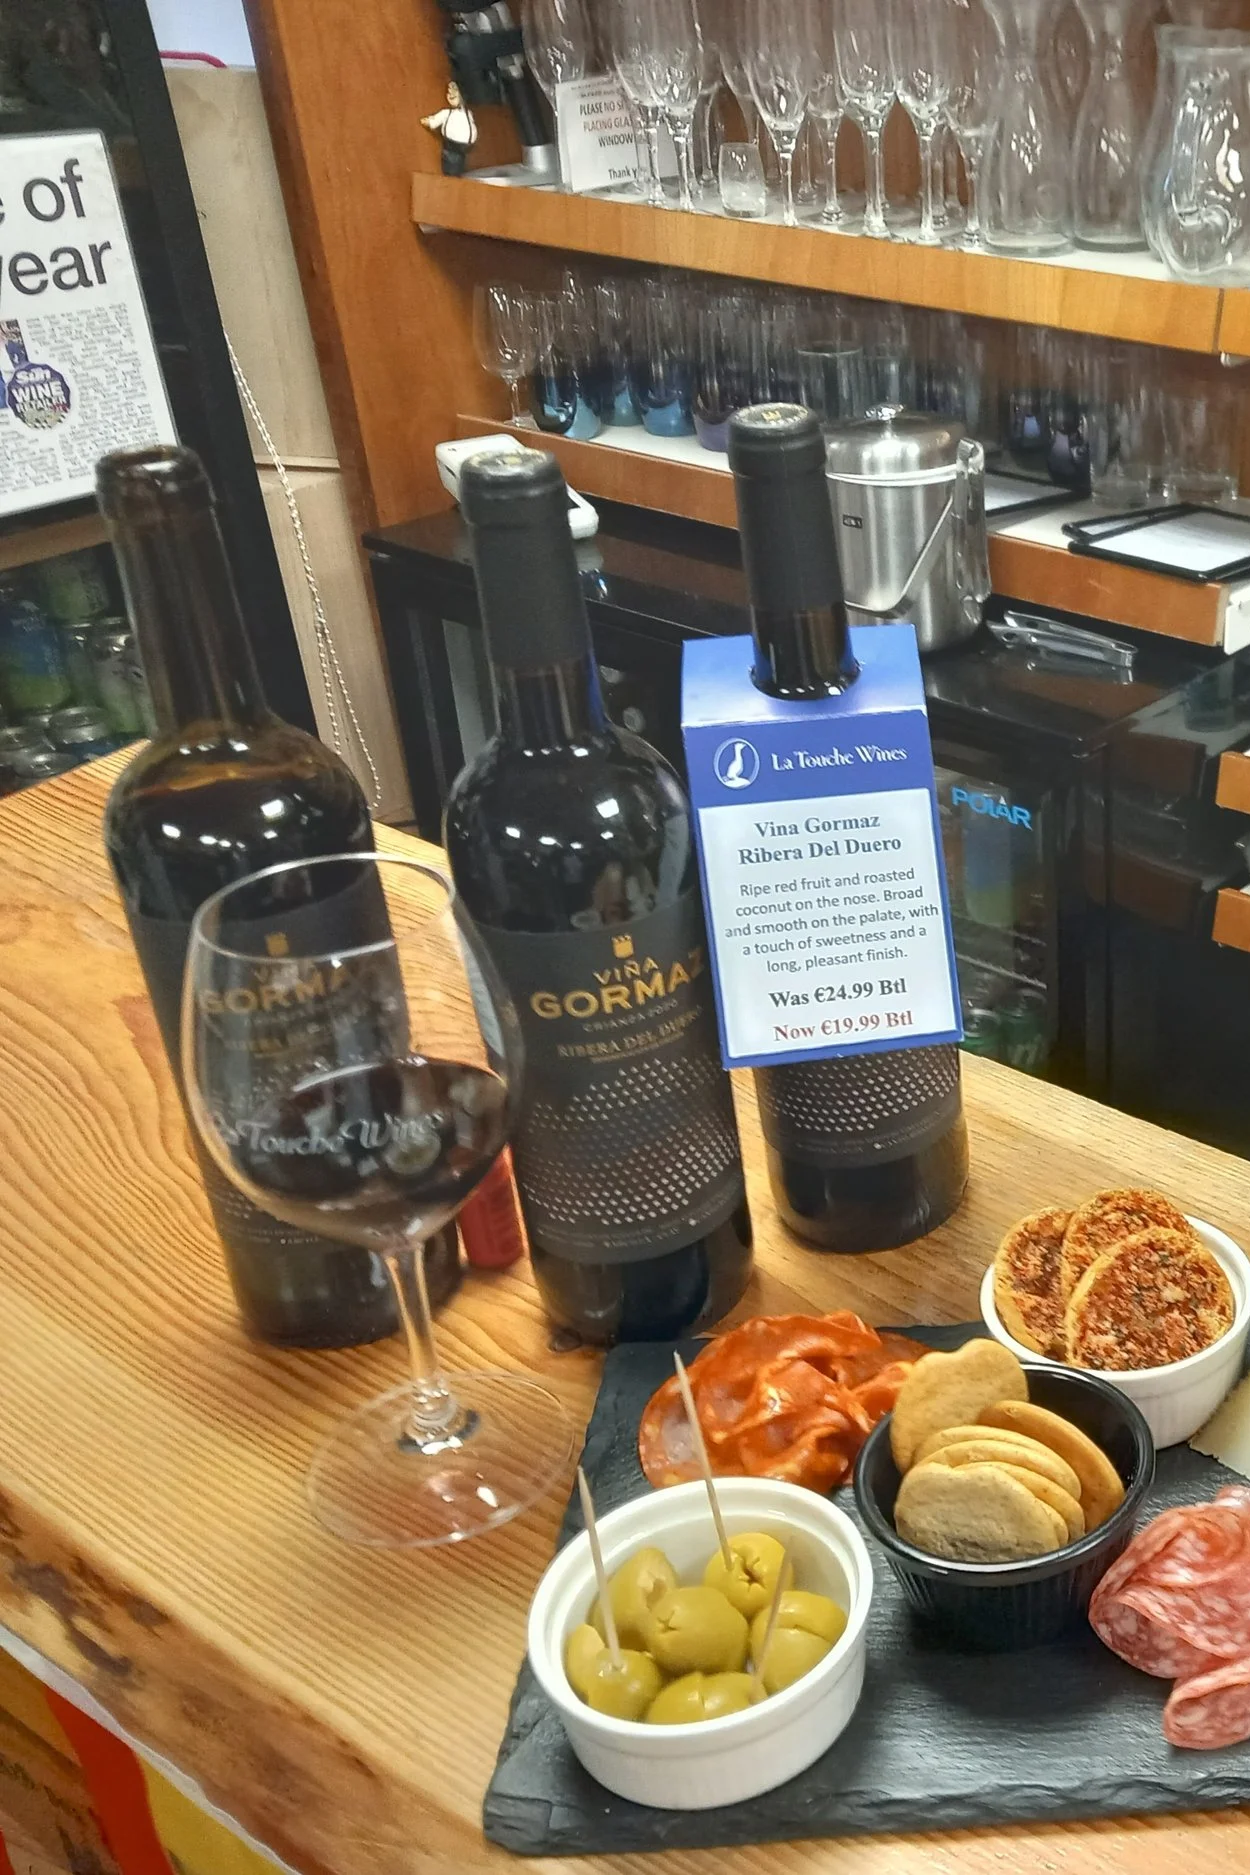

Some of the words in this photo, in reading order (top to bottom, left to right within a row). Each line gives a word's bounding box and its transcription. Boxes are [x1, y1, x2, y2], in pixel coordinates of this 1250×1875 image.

[22, 157, 86, 223] of
[0, 240, 112, 296] ear
[11, 381, 66, 404] WINE
[771, 753, 794, 772] La
[794, 747, 855, 770] Touche
[855, 744, 909, 764] Wines
[951, 786, 1033, 831] POLAR
[754, 822, 799, 838] Vina
[804, 815, 880, 834] Gormaz
[738, 848, 804, 865] Ribera
[808, 841, 841, 859] Del
[844, 836, 902, 855] Duero
[740, 884, 771, 899] Ripe
[774, 879, 798, 894] red
[800, 876, 831, 892] fruit
[834, 872, 861, 887] and
[863, 867, 916, 885] roasted
[735, 901, 793, 917] coconut
[795, 899, 814, 911] on
[816, 894, 840, 909] the
[843, 892, 880, 906] nose.
[883, 886, 924, 902] Broad
[724, 923, 751, 939] and
[754, 918, 809, 935] smooth
[810, 916, 829, 928] on
[832, 911, 856, 926] the
[859, 908, 906, 927] palate,
[908, 904, 939, 918] with
[742, 944, 751, 956] a
[753, 939, 795, 955] touch
[797, 935, 813, 949] of
[815, 929, 887, 947] sweetness
[889, 927, 916, 940] and
[918, 927, 927, 937] a
[766, 959, 802, 974] long,
[805, 952, 864, 972] pleasant
[866, 948, 908, 962] finish.
[768, 991, 810, 1008] Was
[814, 981, 873, 1003] €24.99
[878, 977, 907, 996] Btl
[773, 1023, 816, 1041] Now
[820, 1014, 880, 1036] €19.99
[884, 1010, 913, 1028] Btl
